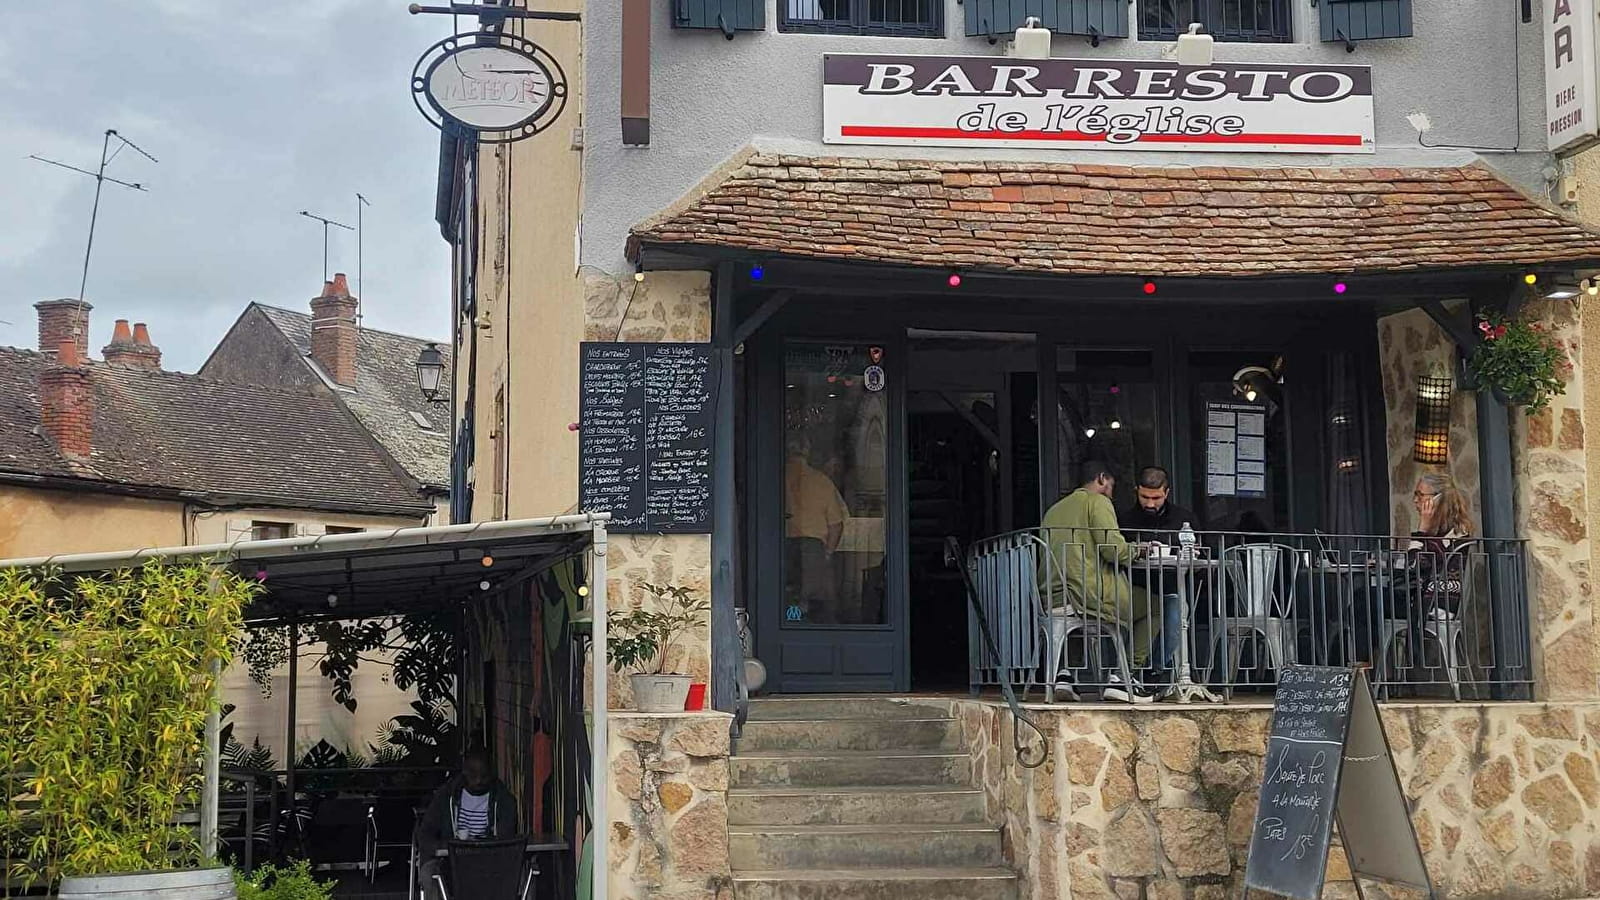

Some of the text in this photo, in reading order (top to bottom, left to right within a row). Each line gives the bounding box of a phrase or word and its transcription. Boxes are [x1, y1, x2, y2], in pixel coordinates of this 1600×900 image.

[858, 63, 1354, 103] BAR RESTO
[1555, 85, 1575, 108] BIERE
[956, 103, 1245, 144] de l'église
[1550, 108, 1582, 136] PRESSION
